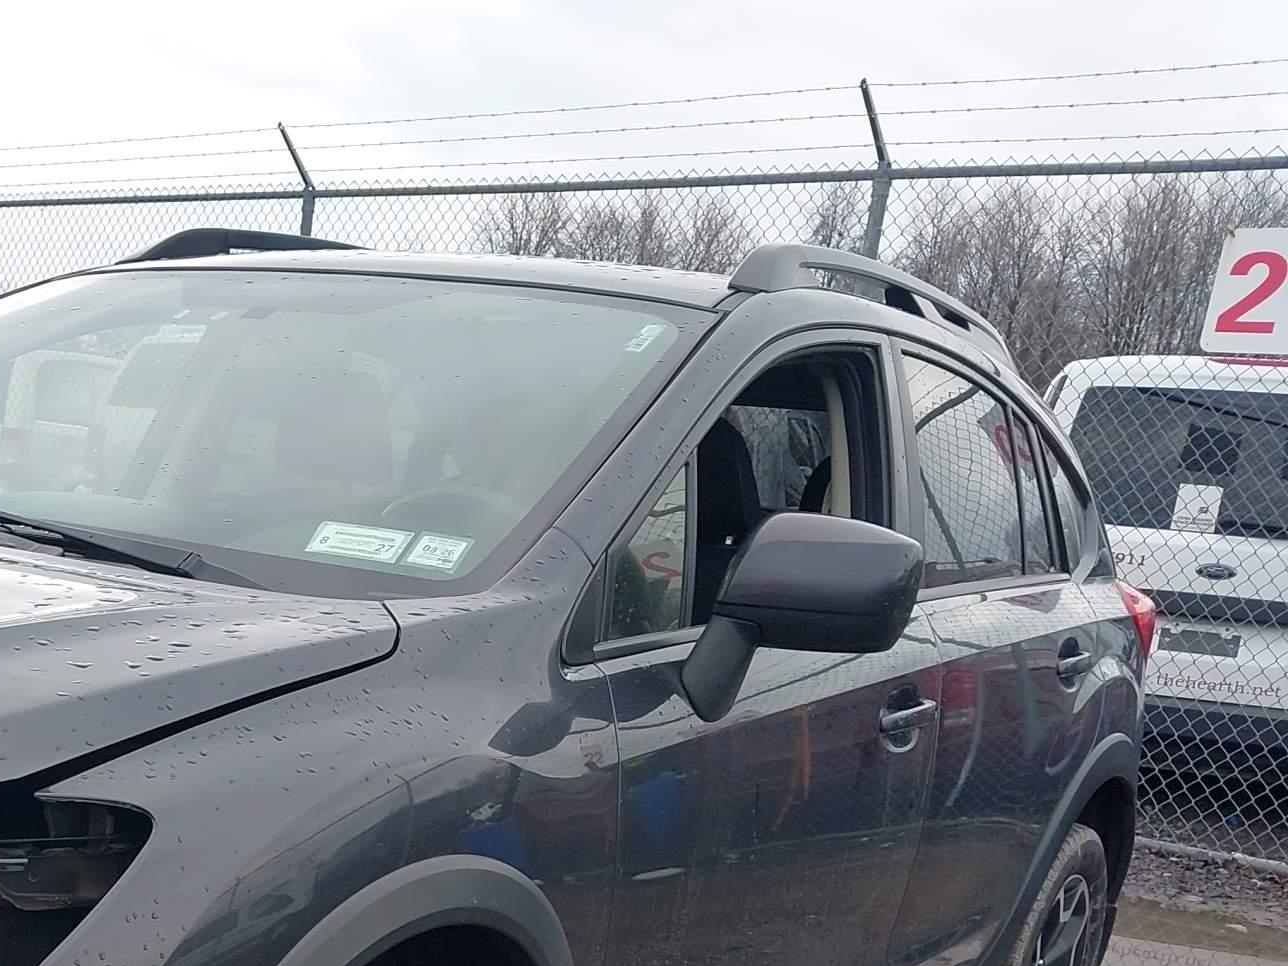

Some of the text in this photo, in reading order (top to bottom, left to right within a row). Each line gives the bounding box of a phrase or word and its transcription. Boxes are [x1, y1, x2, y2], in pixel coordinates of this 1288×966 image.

[1215, 251, 1288, 333] 2
[374, 543, 395, 553] 27
[1113, 552, 1146, 567] 911
